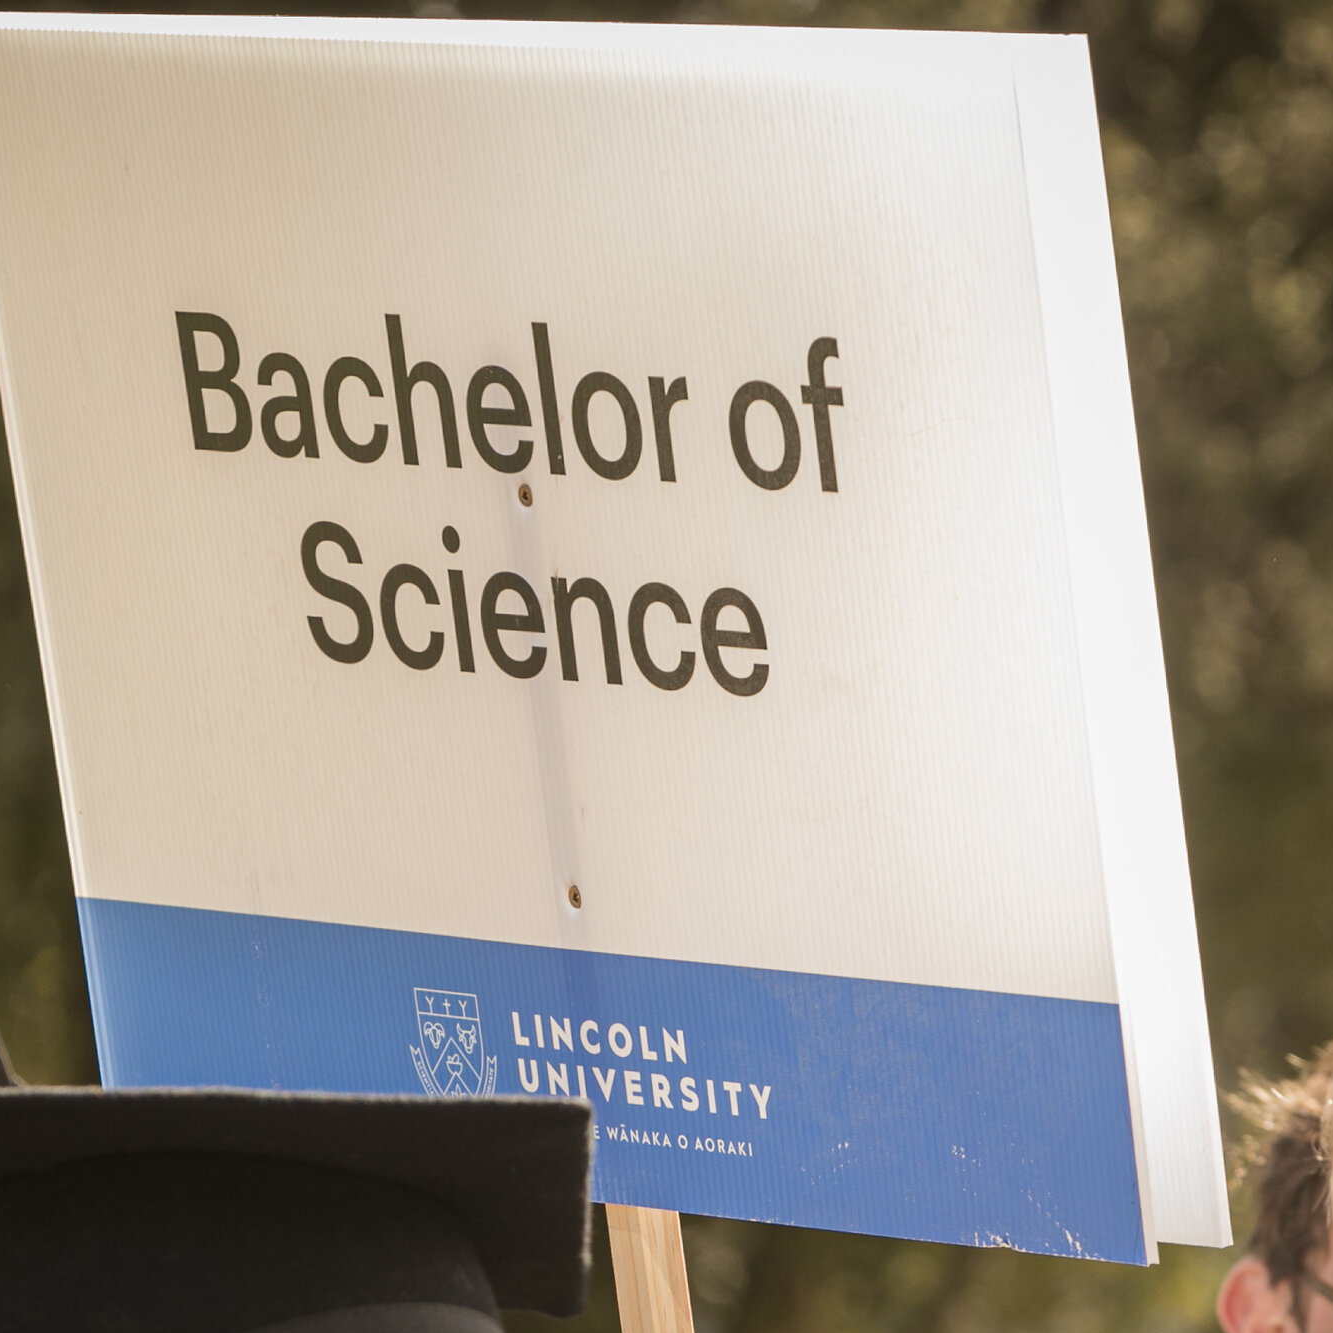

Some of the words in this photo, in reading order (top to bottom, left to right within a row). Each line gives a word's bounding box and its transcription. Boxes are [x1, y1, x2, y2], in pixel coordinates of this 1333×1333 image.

[175, 311, 689, 483] Bachelor
[728, 336, 845, 494] of
[300, 520, 770, 697] Science
[511, 1011, 687, 1064] LINCOLN
[517, 1057, 771, 1119] UNIVERSITY
[606, 1124, 672, 1148] WĀNAKA
[677, 1134, 689, 1149] O
[694, 1136, 754, 1158] AORAKI
